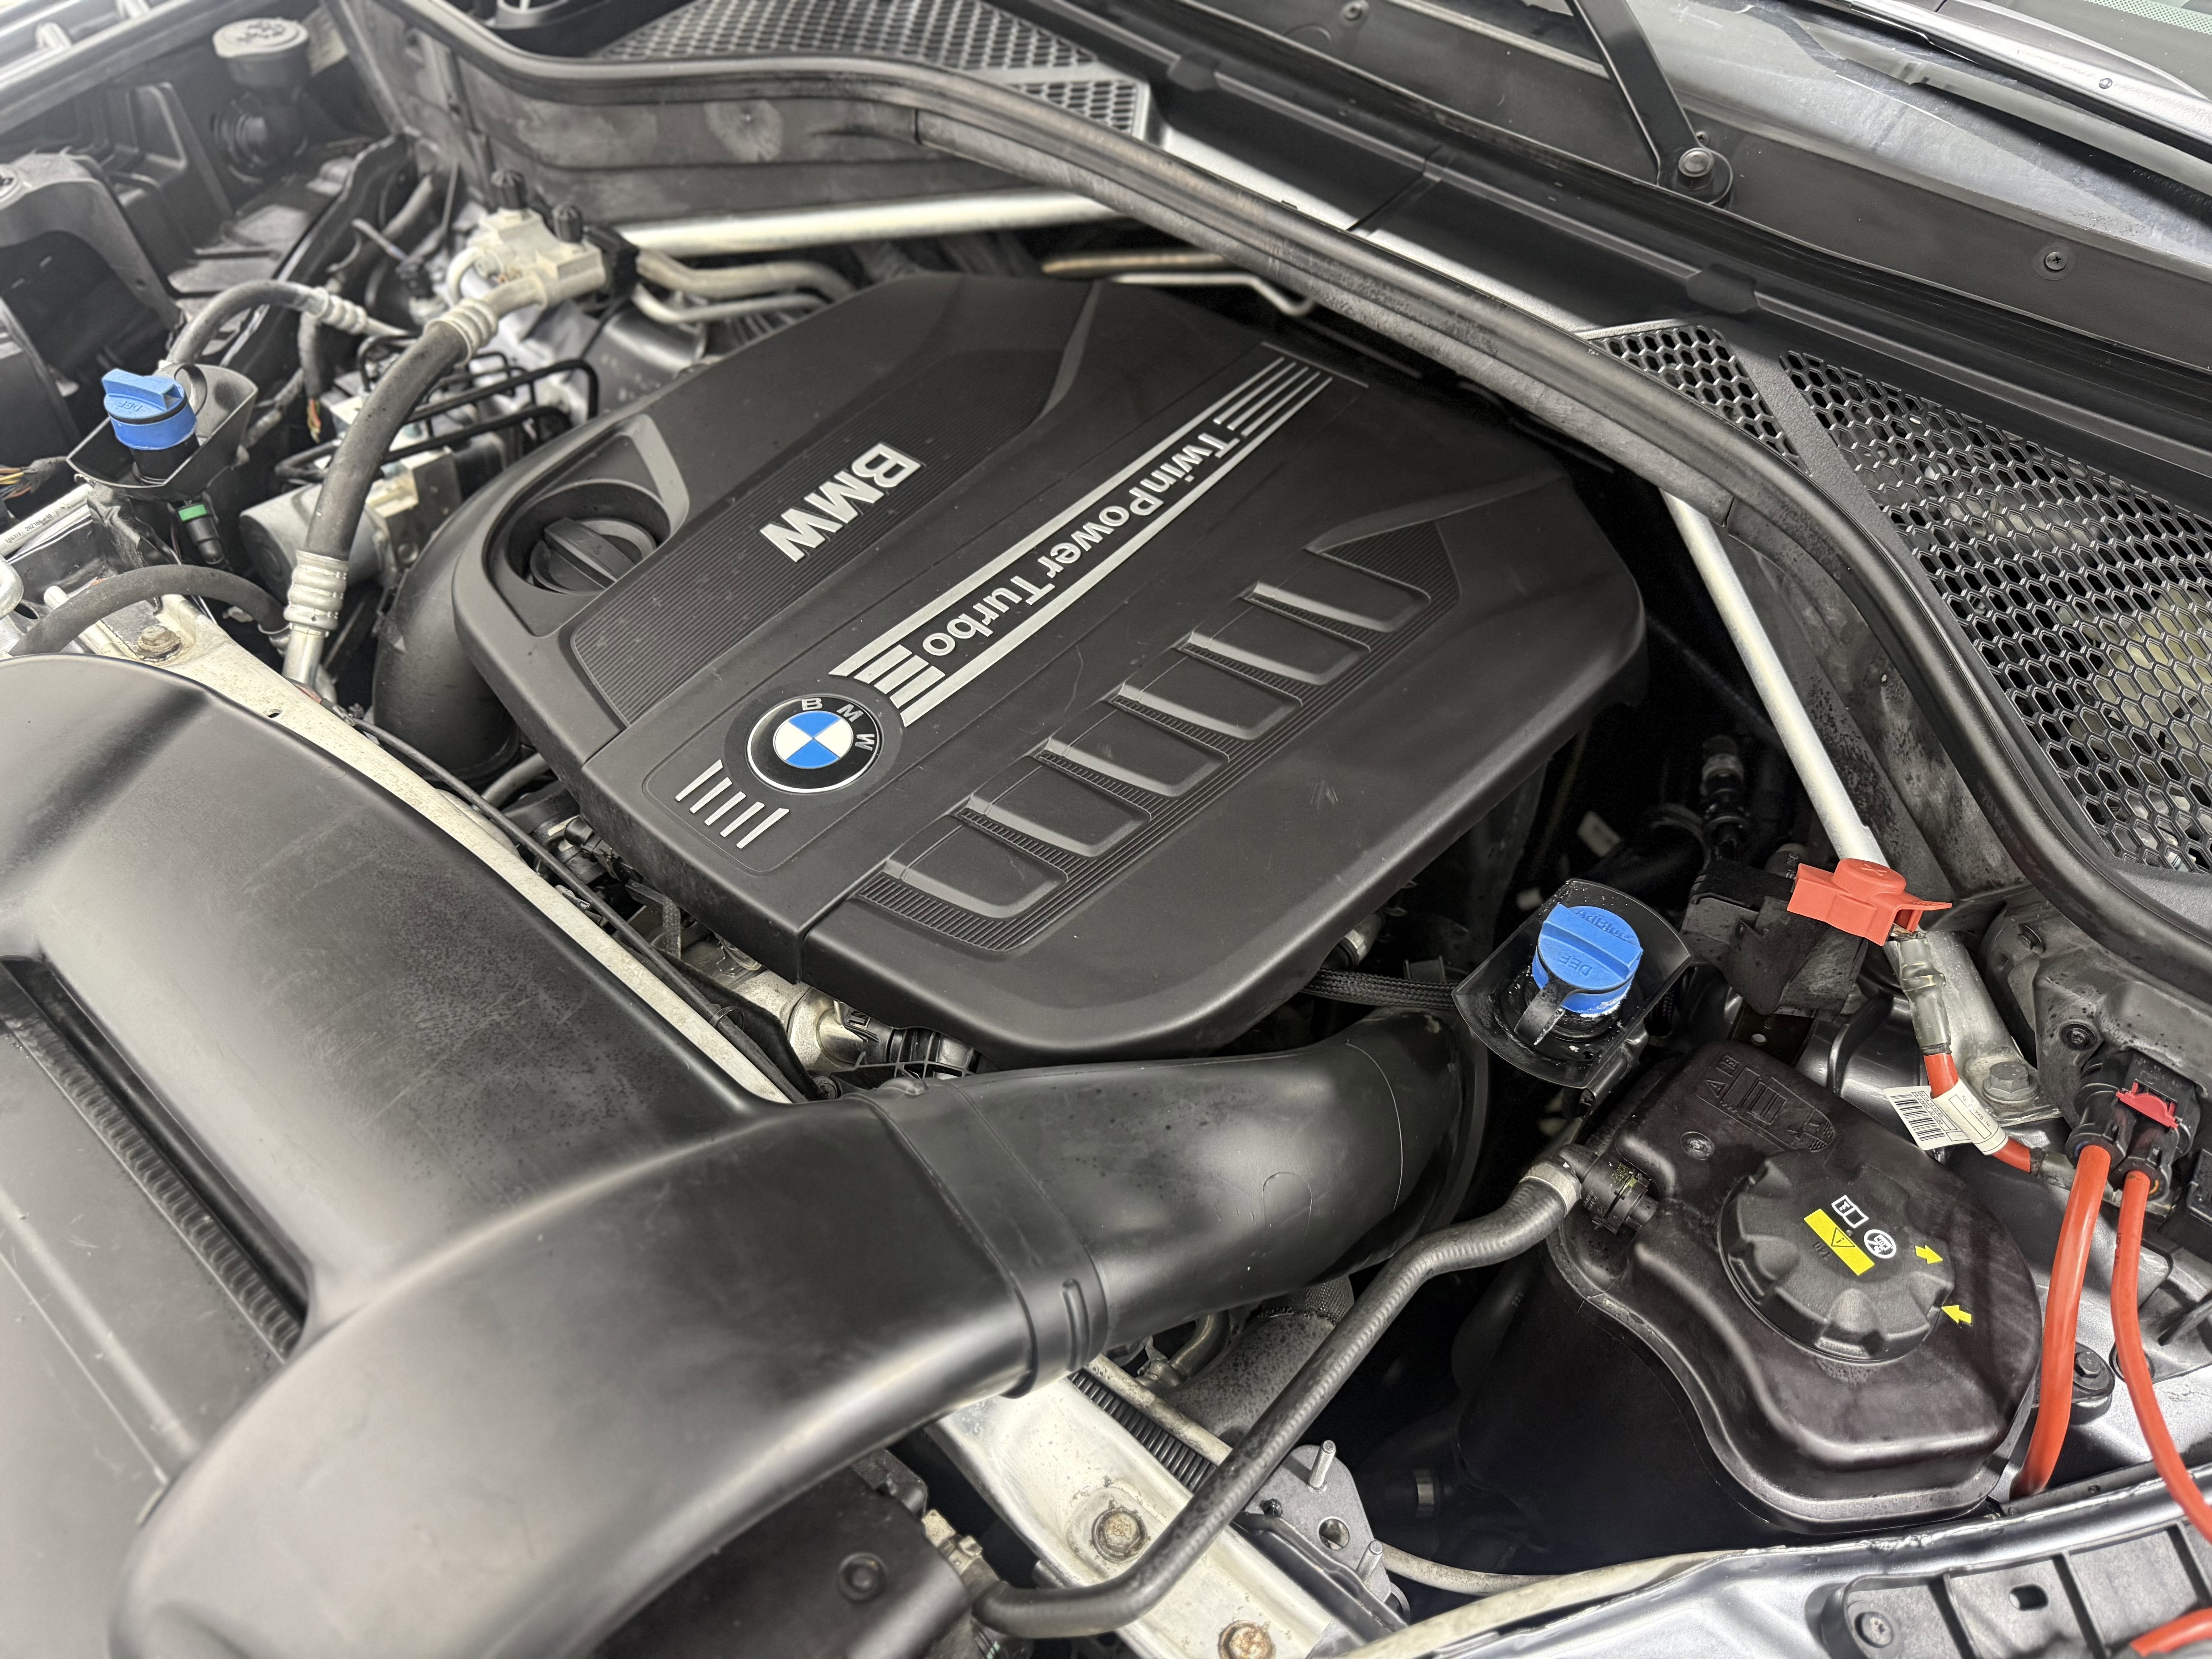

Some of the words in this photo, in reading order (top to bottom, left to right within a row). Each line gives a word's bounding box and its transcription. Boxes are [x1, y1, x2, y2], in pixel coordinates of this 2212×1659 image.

[117, 402, 143, 412] DEF
[760, 443, 921, 562] BMW
[802, 697, 875, 751] BMW
[1558, 956, 1593, 977] DEF
